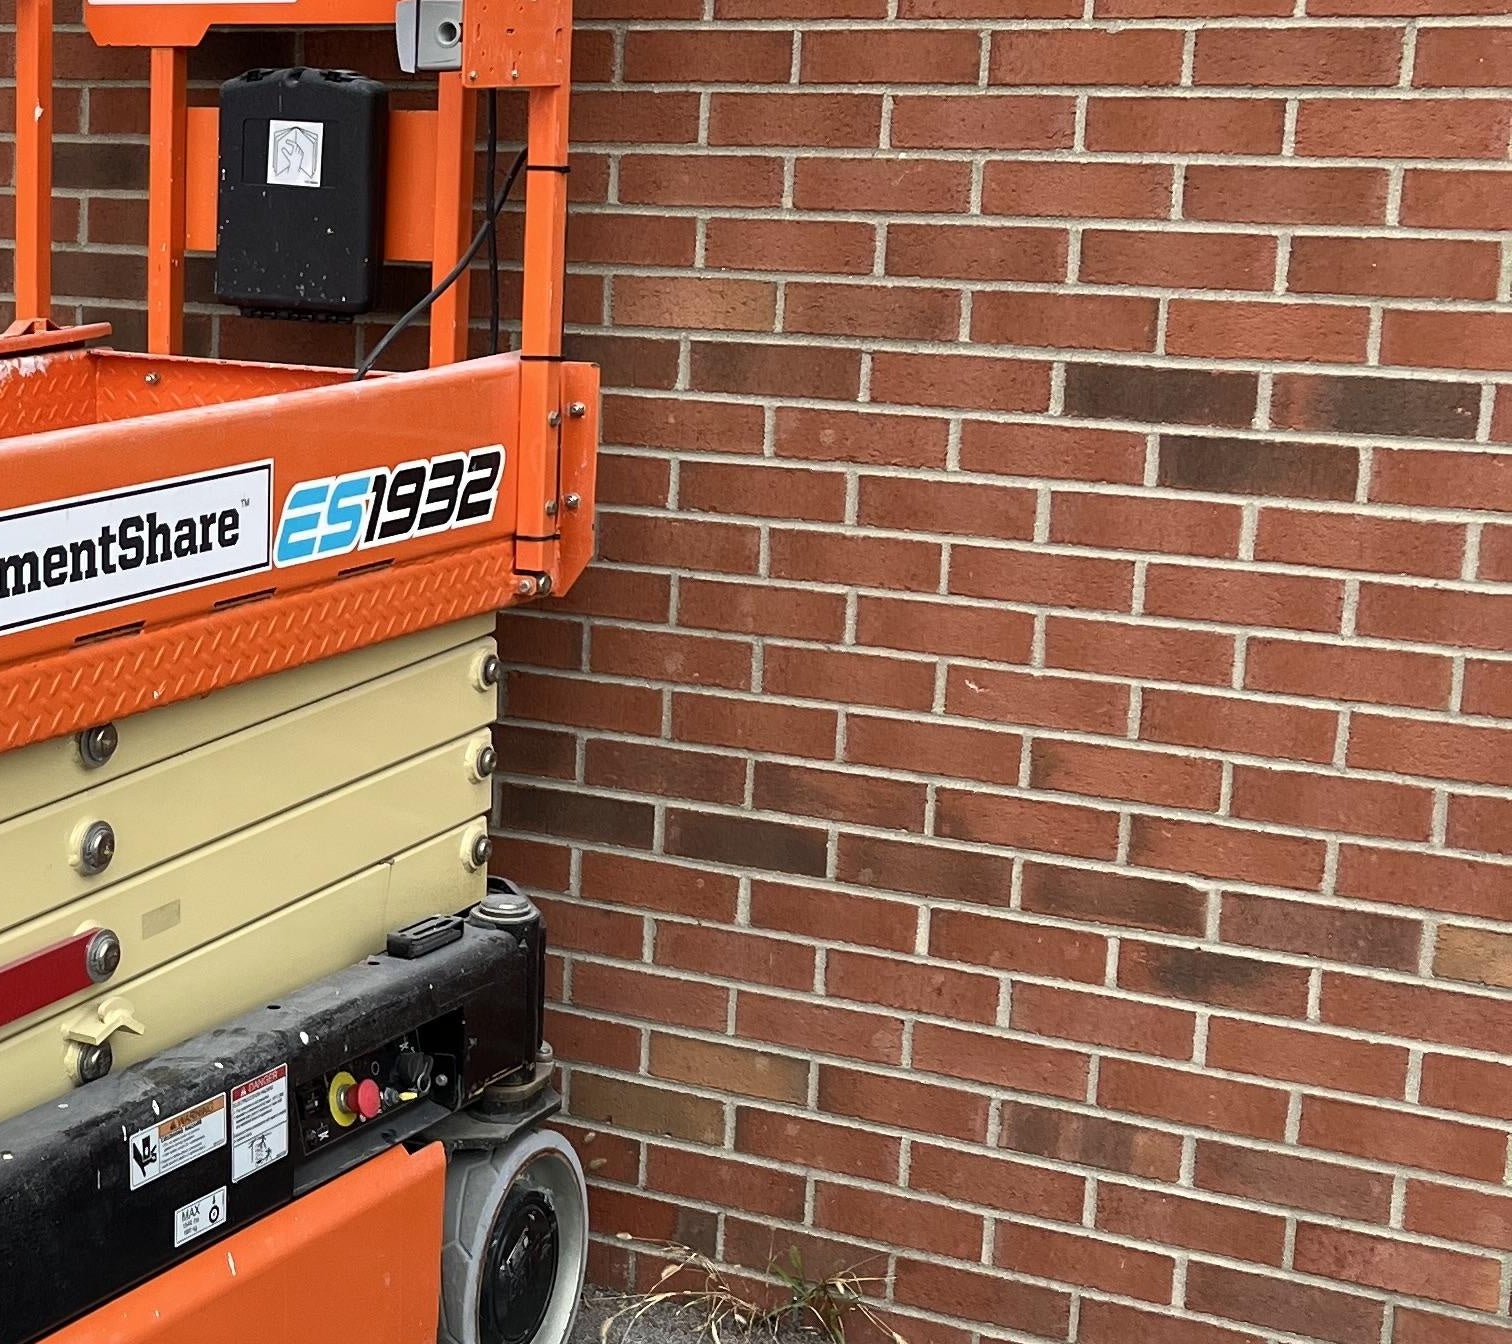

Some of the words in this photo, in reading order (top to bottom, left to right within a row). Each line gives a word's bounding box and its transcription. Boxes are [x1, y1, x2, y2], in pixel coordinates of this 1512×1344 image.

[278, 452, 501, 563] ES1932
[247, 1071, 278, 1094] DANGER
[181, 1204, 200, 1223] MAX
